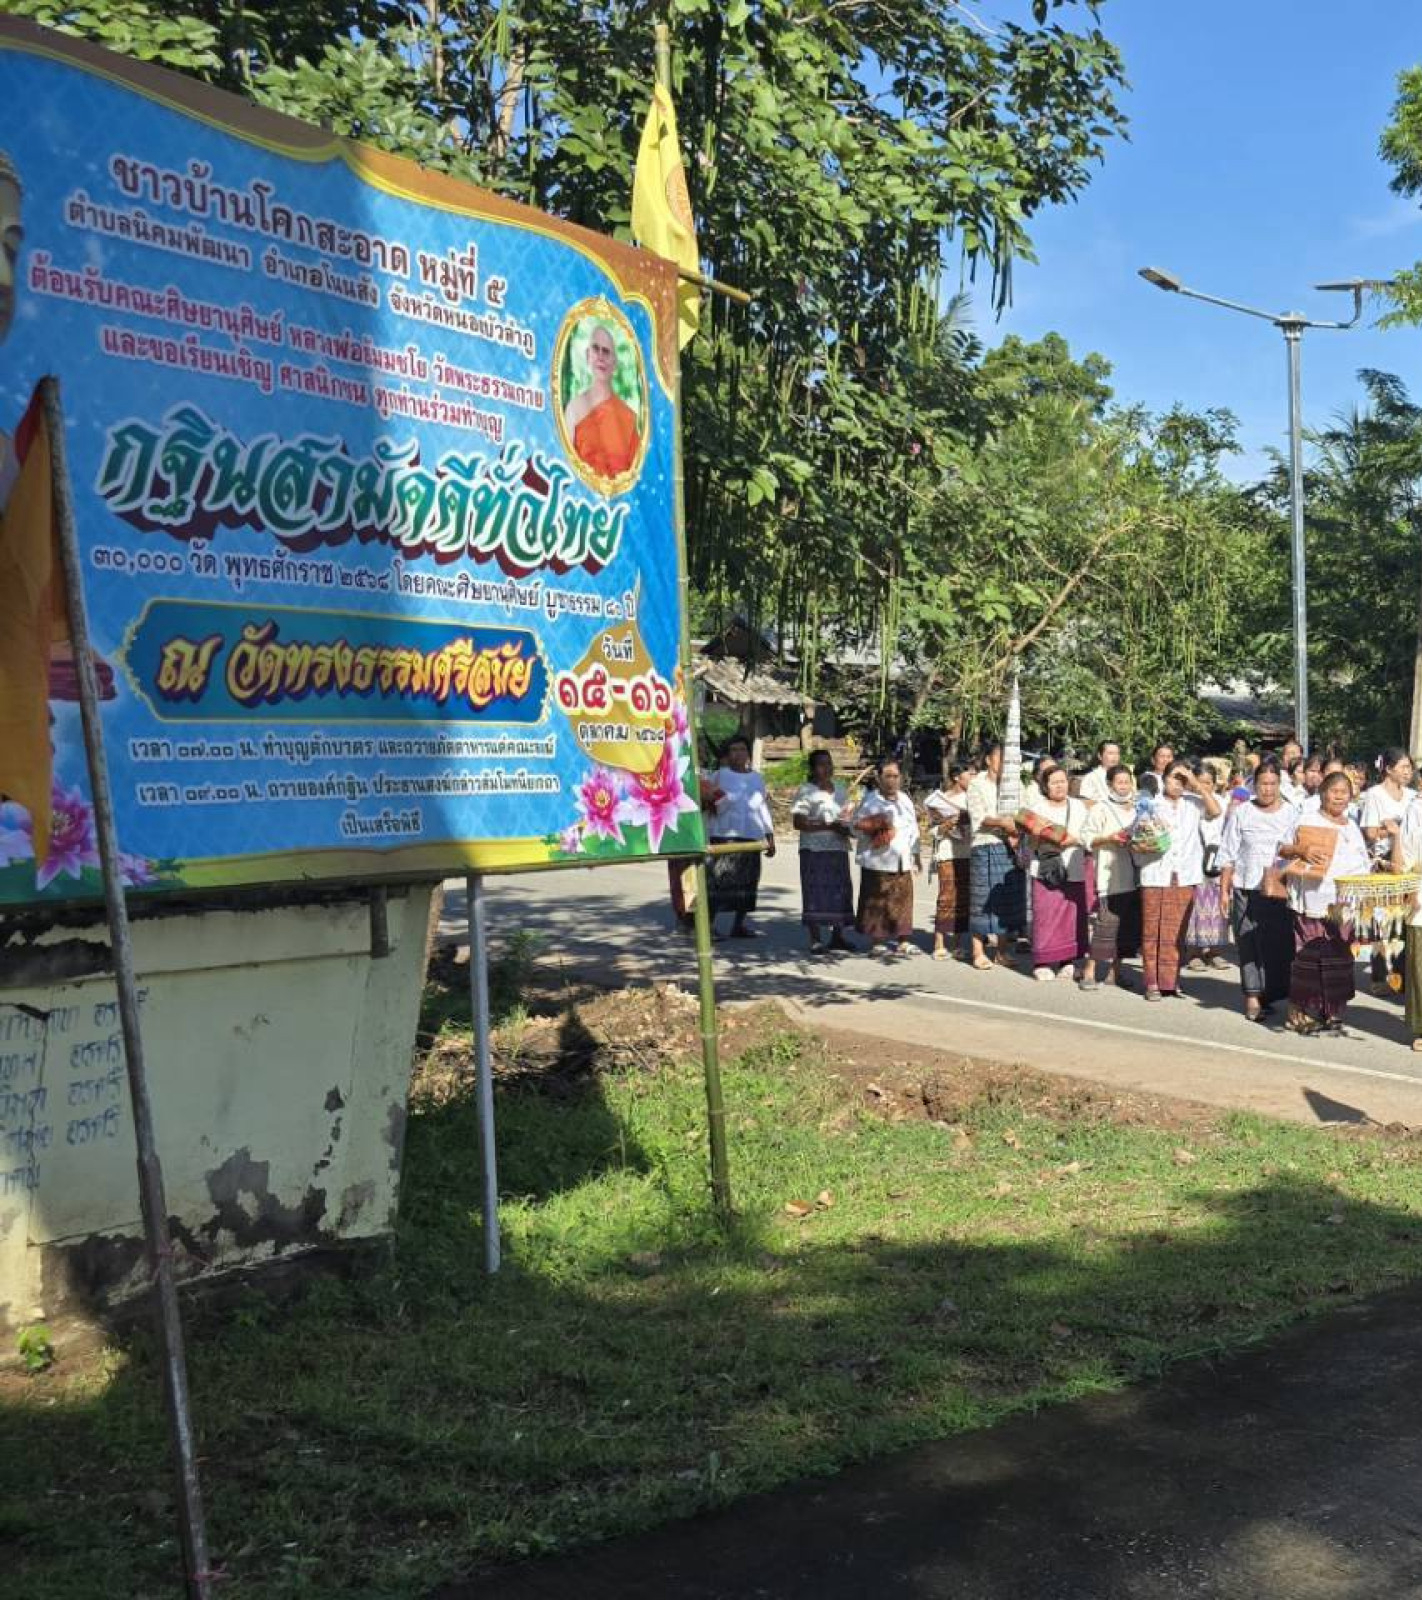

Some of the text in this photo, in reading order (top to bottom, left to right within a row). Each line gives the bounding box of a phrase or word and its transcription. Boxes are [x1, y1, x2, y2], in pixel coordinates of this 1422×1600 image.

[68, 193, 250, 267] ตำบลนิคมพัฒนา
[264, 246, 379, 306] อำเภอโนนสัง
[111, 157, 506, 305] ชาวบ้านโคกสะอาด หมู่ที่ ๕
[31, 252, 283, 343] ต้อนรับคณะศิษยานุศิษย์
[432, 354, 544, 409] วัดพระธรรมกาย
[102, 329, 272, 392] และขอเรียนเชิญ
[99, 406, 627, 566] กฐินสามัคคีทั่วไทย
[94, 549, 183, 573] ๓๐,๐๐๐
[190, 541, 216, 575] วัด
[226, 548, 333, 589] พุทธศักราช
[340, 567, 389, 589] ๒๕๖๘
[395, 560, 540, 610] โดยคณะศิษยานุศิษย์
[157, 619, 536, 707] ณ วัดทรงธรรมศรีสมัย
[602, 632, 634, 661] วันที่
[558, 668, 671, 712] ๑๕-๑๖
[131, 740, 171, 758] เวลา
[239, 740, 258, 758] น.
[264, 734, 374, 763] ทำบุญตักบาตร
[579, 723, 629, 747] ตุลาคม
[139, 785, 179, 803] เวลา
[244, 782, 263, 798] น.
[268, 772, 369, 801] ถวายองค์กฐิน
